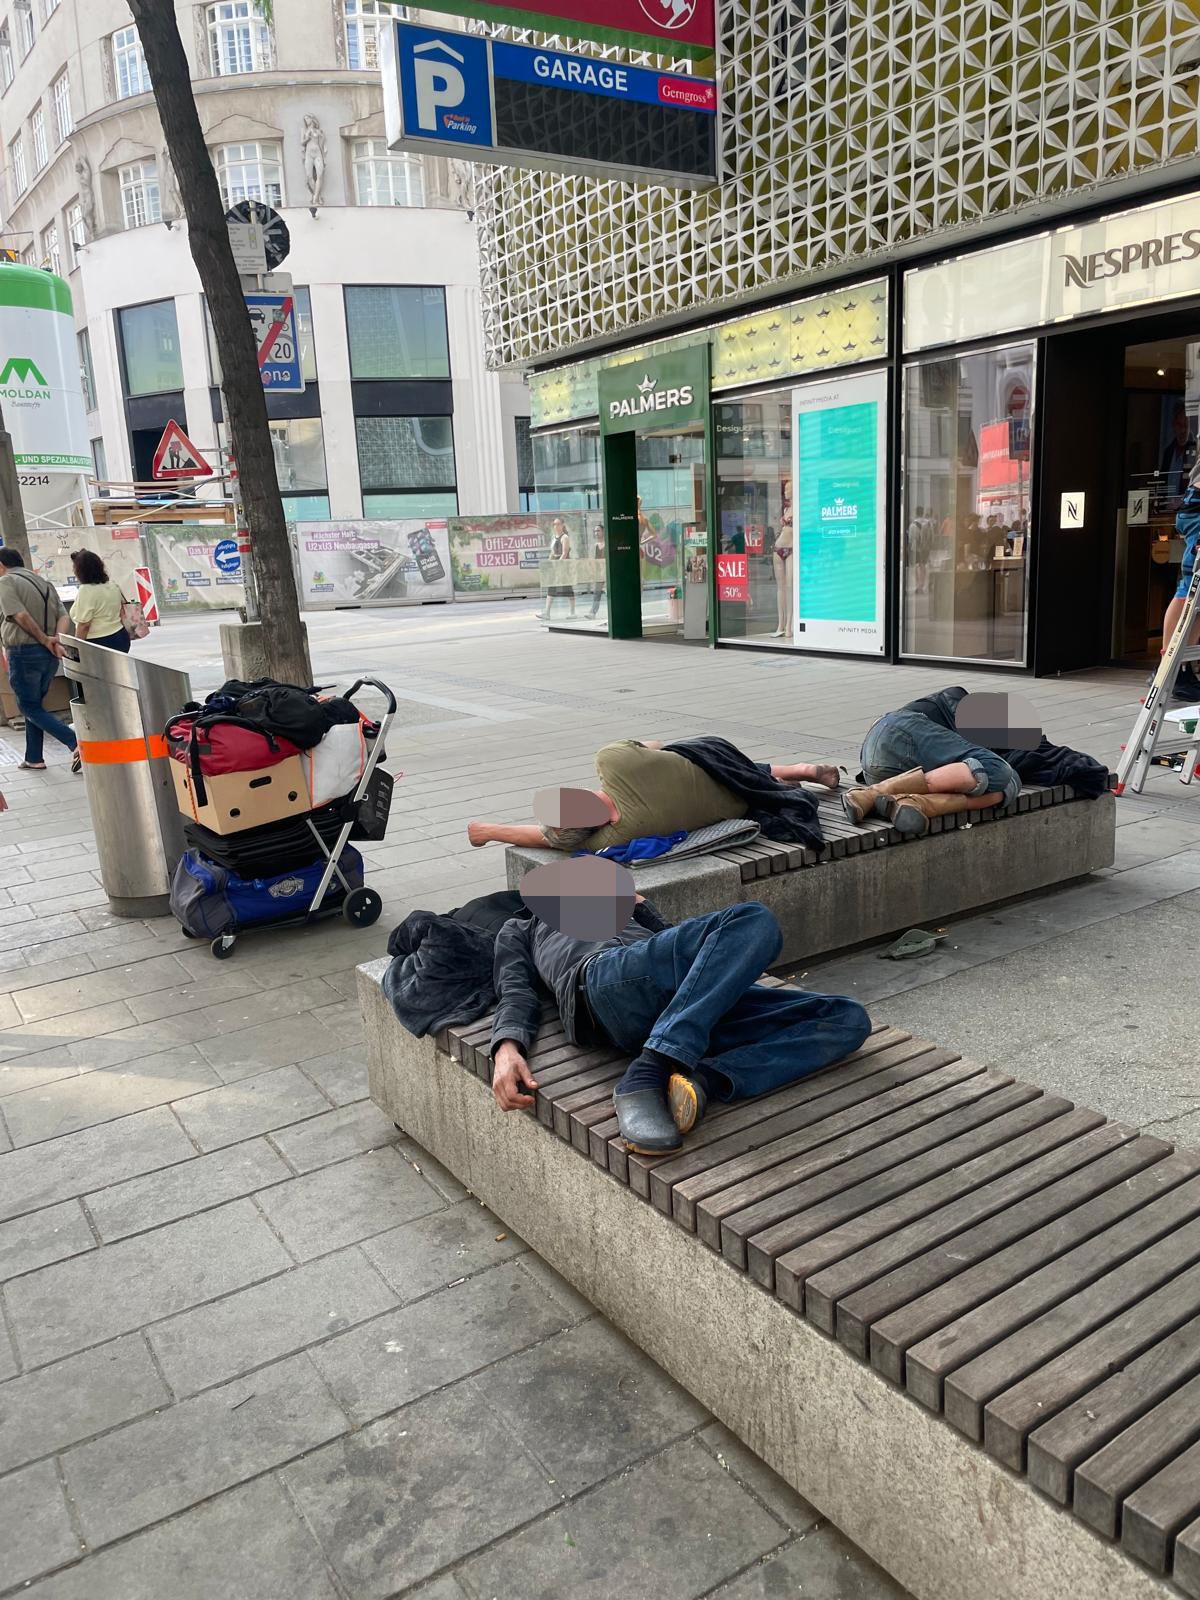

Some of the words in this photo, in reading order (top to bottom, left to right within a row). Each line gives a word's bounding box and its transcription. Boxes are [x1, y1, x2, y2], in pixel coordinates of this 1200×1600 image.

[533, 55, 628, 92] GARAGE
[414, 58, 465, 131] P
[662, 85, 707, 104] Gerngross
[447, 120, 477, 135] Parking
[274, 342, 292, 359] 20
[0, 389, 51, 399] MOLDAN
[610, 386, 694, 419] PALMERS
[22, 455, 40, 463] UND
[821, 505, 858, 517] PALMERS
[334, 543, 378, 551] Neubaugasse
[645, 543, 663, 562] U2
[480, 553, 515, 567] U2xU5
[718, 560, 746, 578] SALE
